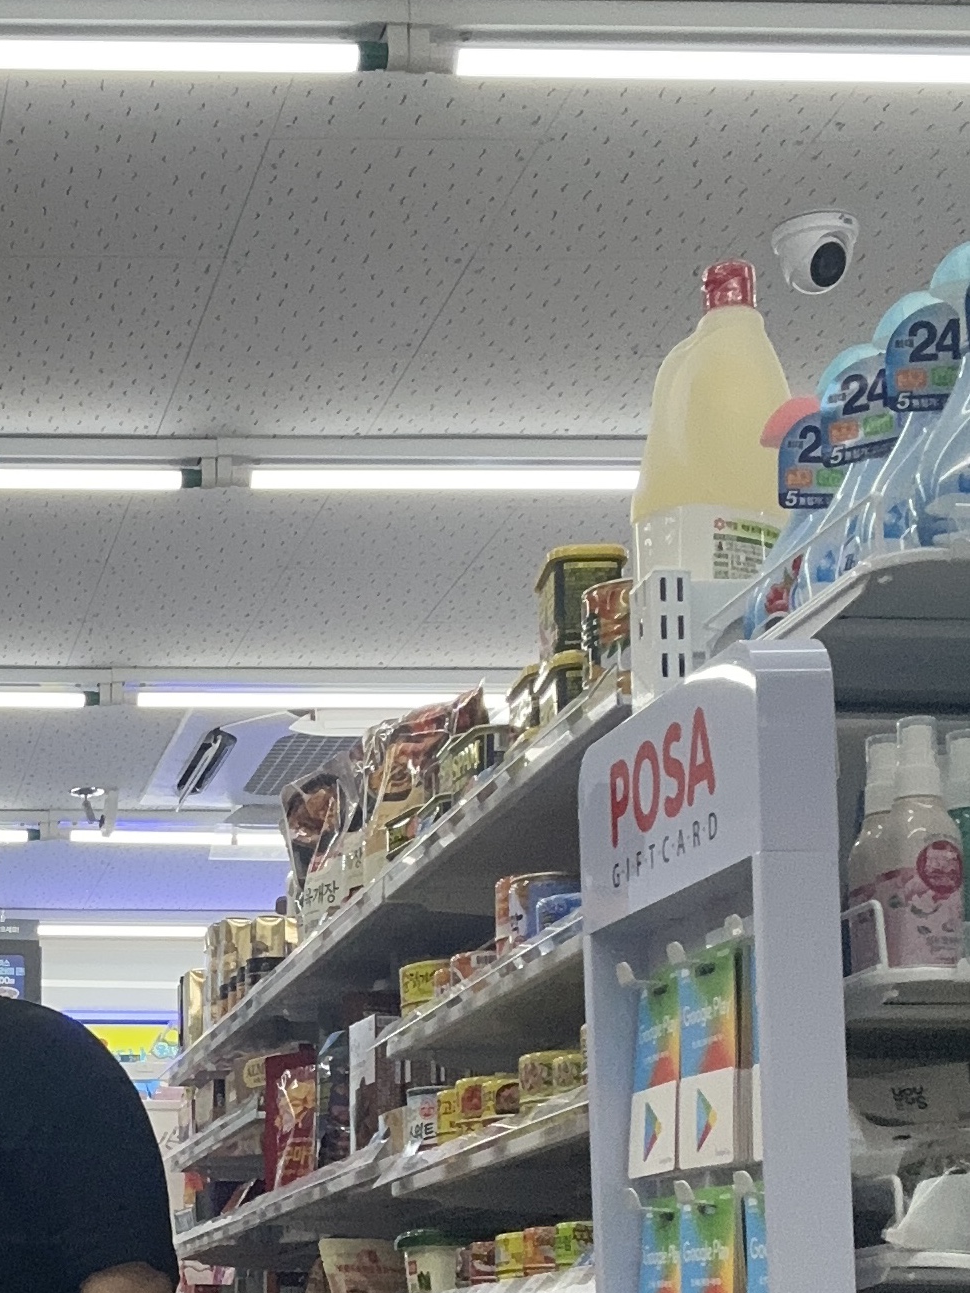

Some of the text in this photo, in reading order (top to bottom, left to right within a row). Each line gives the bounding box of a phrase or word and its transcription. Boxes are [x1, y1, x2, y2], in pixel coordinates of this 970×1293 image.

[908, 318, 962, 363] 24
[798, 424, 823, 464] 2
[609, 706, 717, 848] POSA
